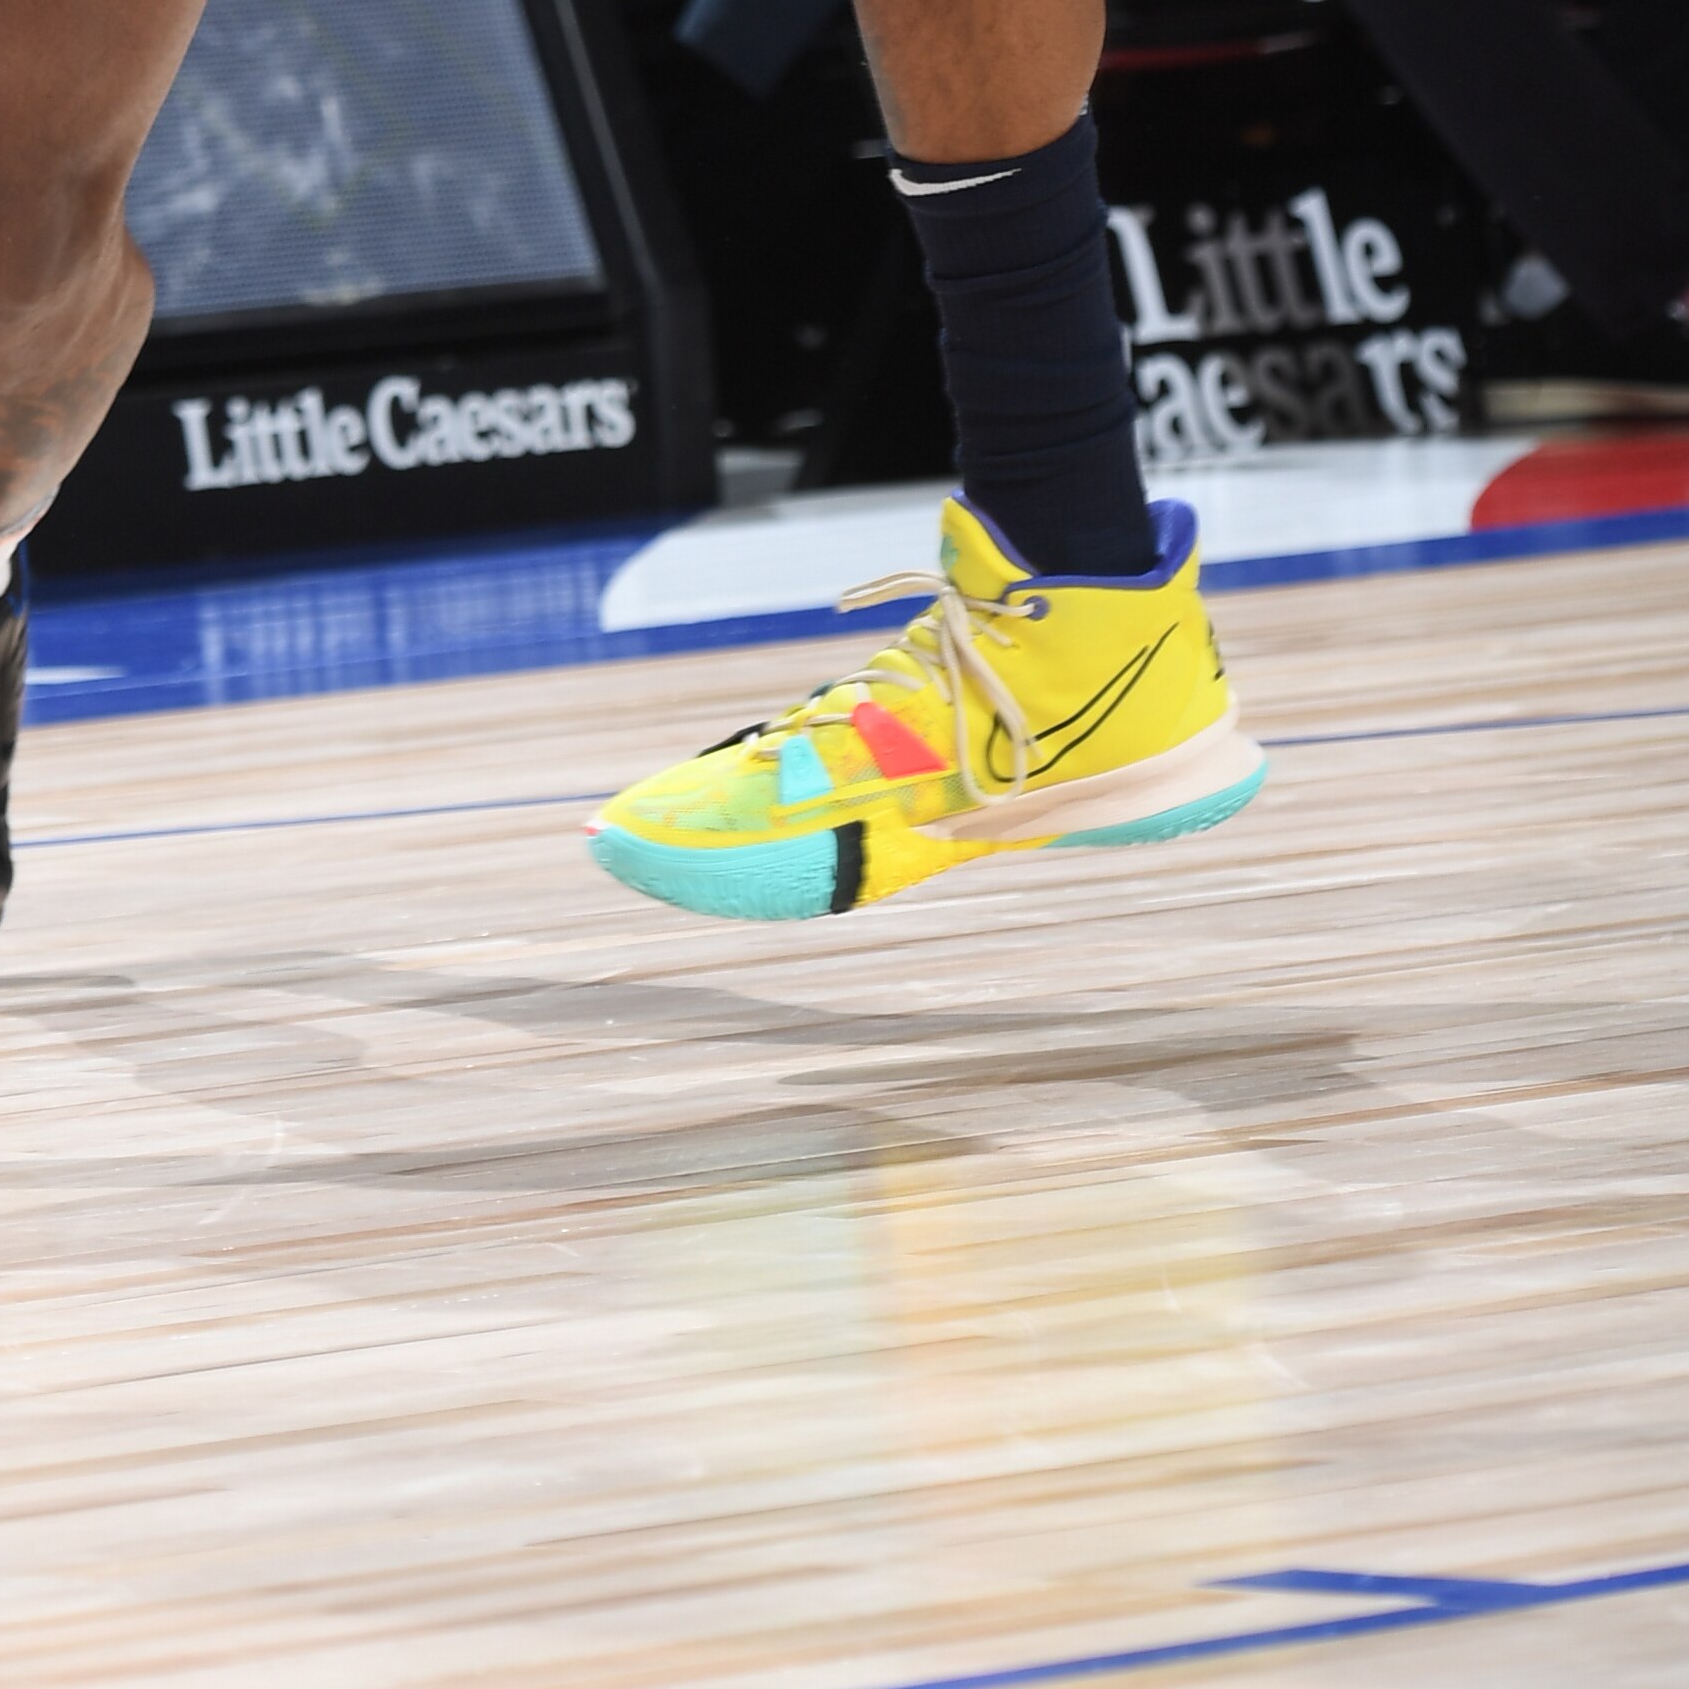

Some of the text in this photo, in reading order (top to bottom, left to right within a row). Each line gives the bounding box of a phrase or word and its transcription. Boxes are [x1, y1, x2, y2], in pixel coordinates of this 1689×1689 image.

[1108, 188, 1409, 341] Little
[173, 375, 637, 490] Little Caesars
[1126, 326, 1468, 460] aesars
